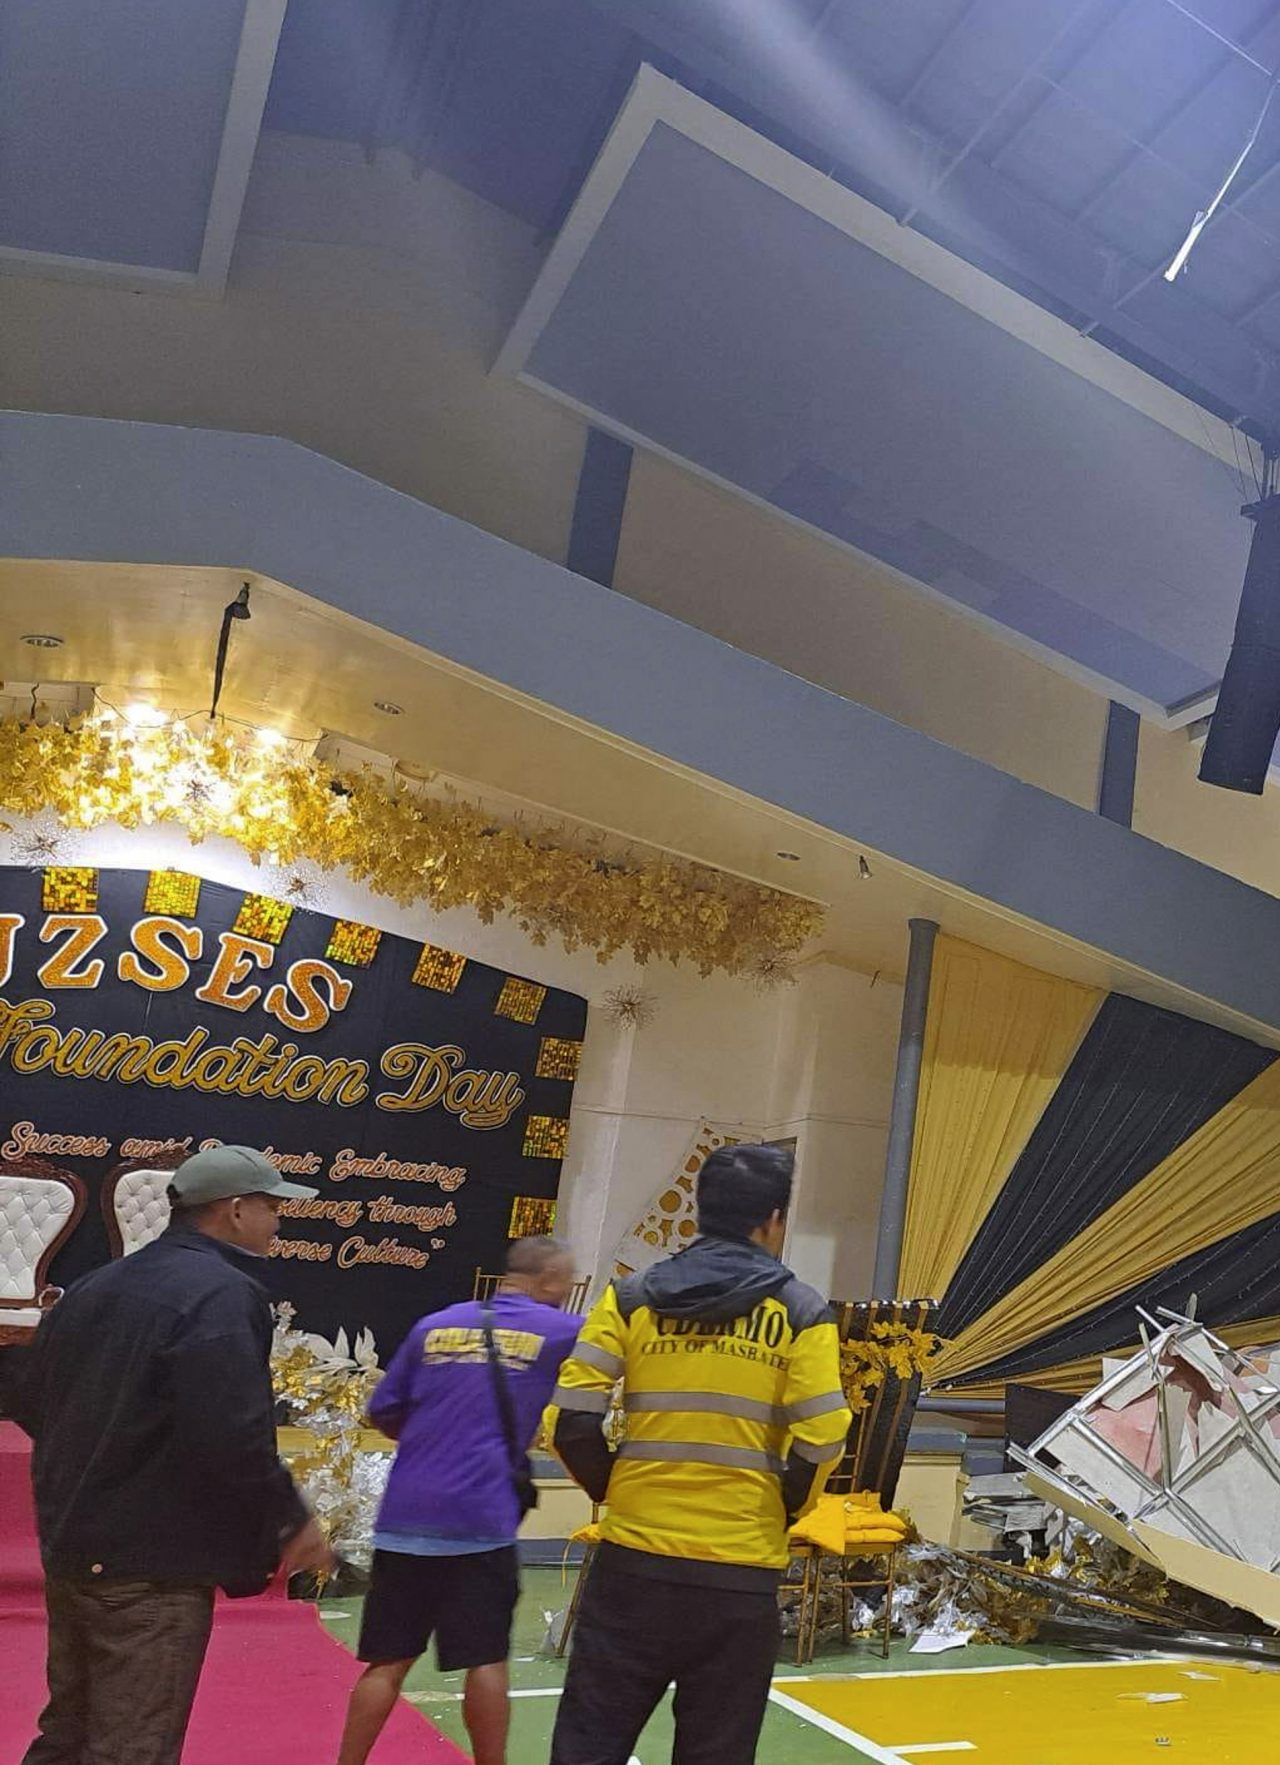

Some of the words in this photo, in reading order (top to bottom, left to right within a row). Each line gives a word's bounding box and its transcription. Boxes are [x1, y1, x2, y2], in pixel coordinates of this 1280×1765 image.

[0, 998, 369, 1107] Foundation
[376, 1043, 525, 1130] Day
[1, 1121, 112, 1161] Success
[329, 1149, 466, 1192] Embracing
[368, 1195, 457, 1232] through
[642, 1339, 679, 1355] CITY
[684, 1337, 706, 1354] OF
